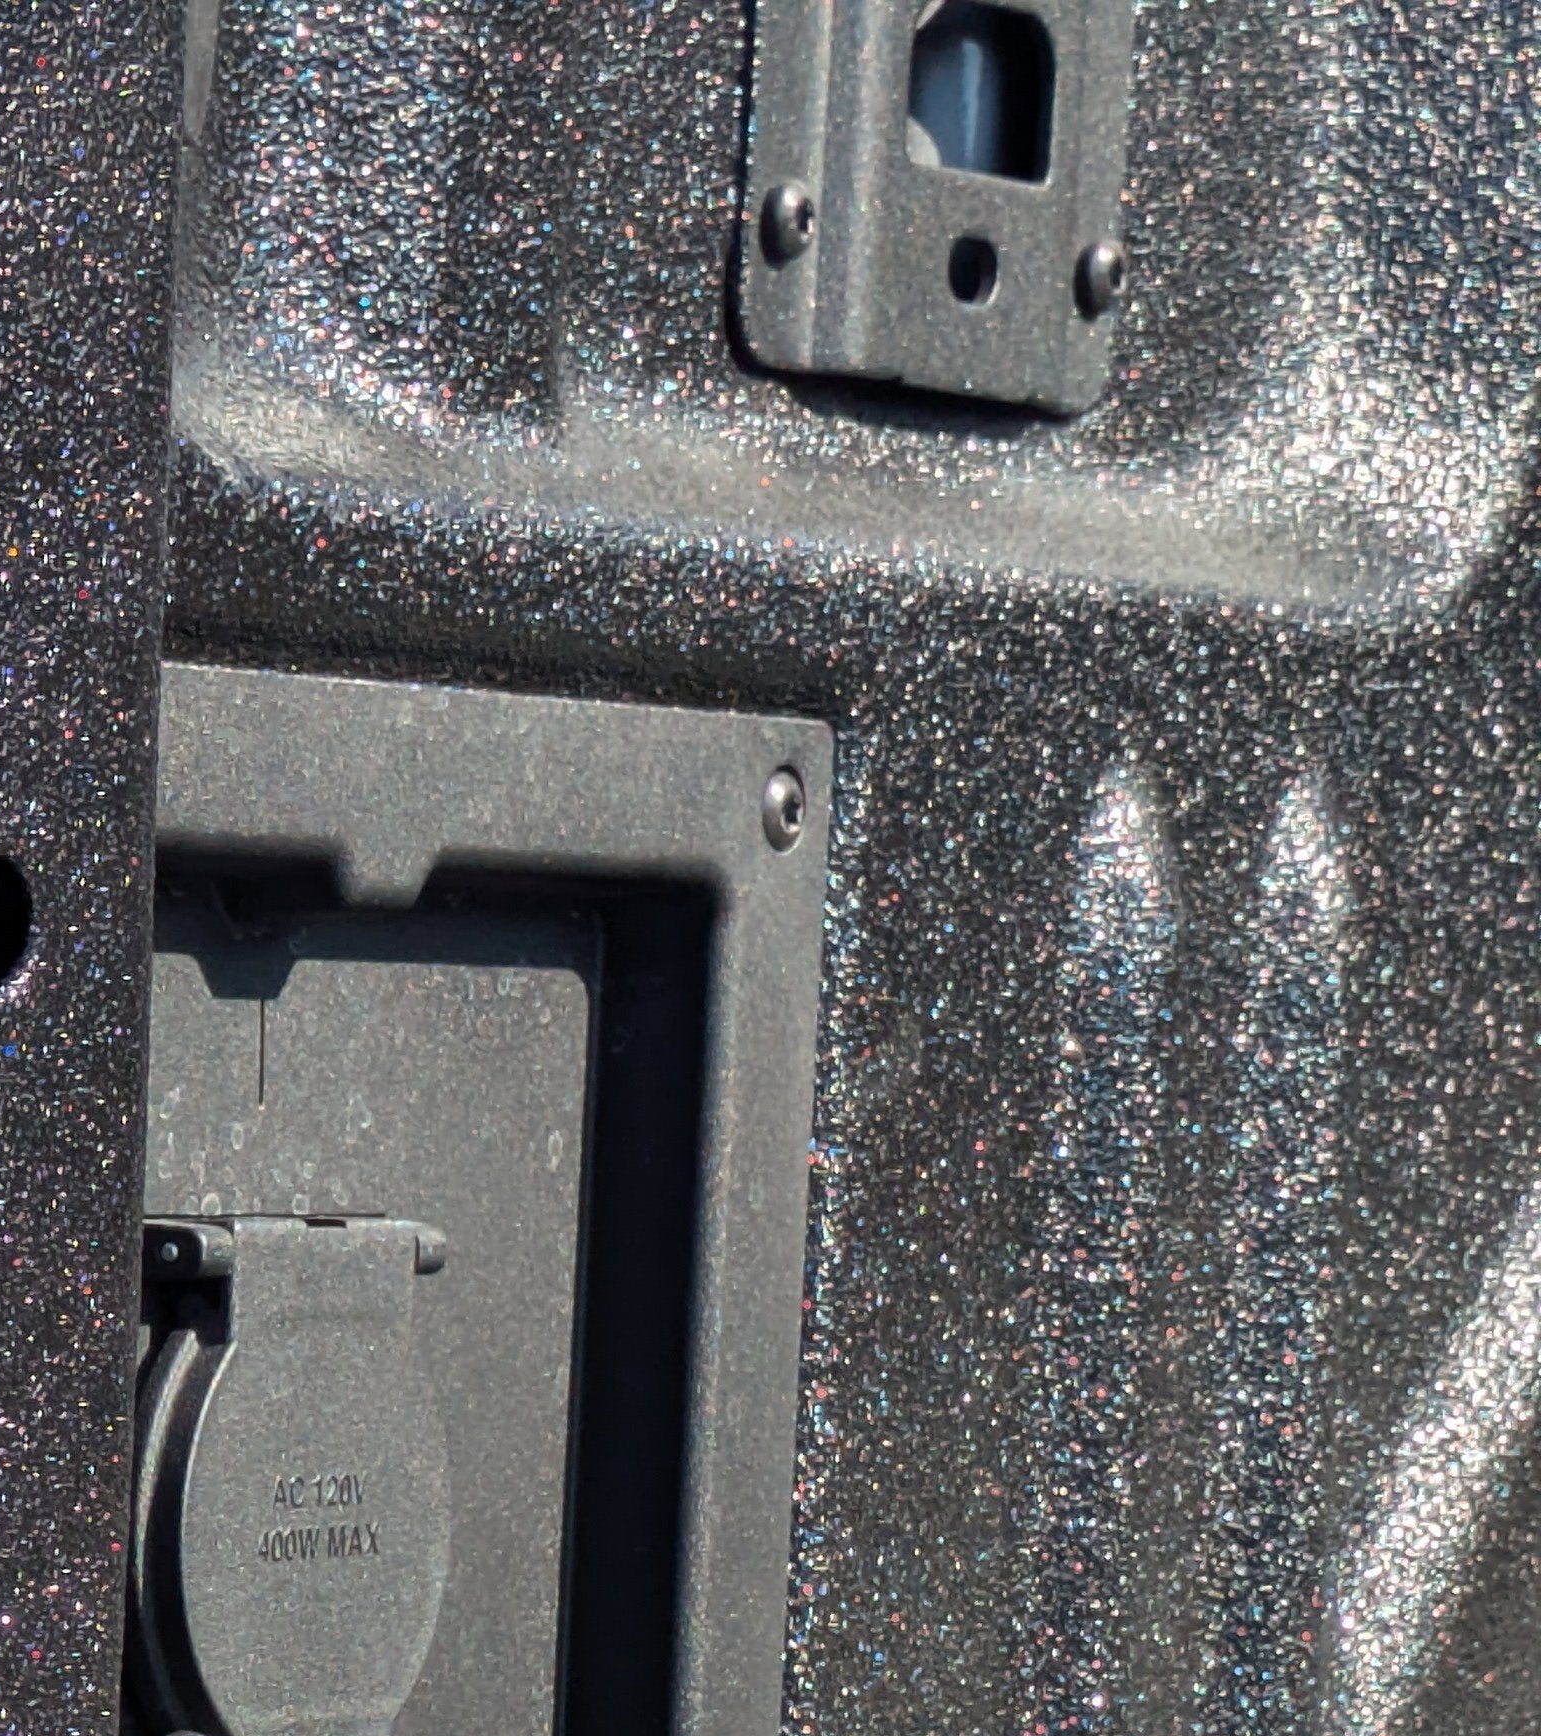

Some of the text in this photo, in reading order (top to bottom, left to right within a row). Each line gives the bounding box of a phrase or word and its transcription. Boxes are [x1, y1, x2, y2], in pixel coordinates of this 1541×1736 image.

[272, 1471, 367, 1510] AC 120V
[257, 1521, 379, 1562] 400W MAX
